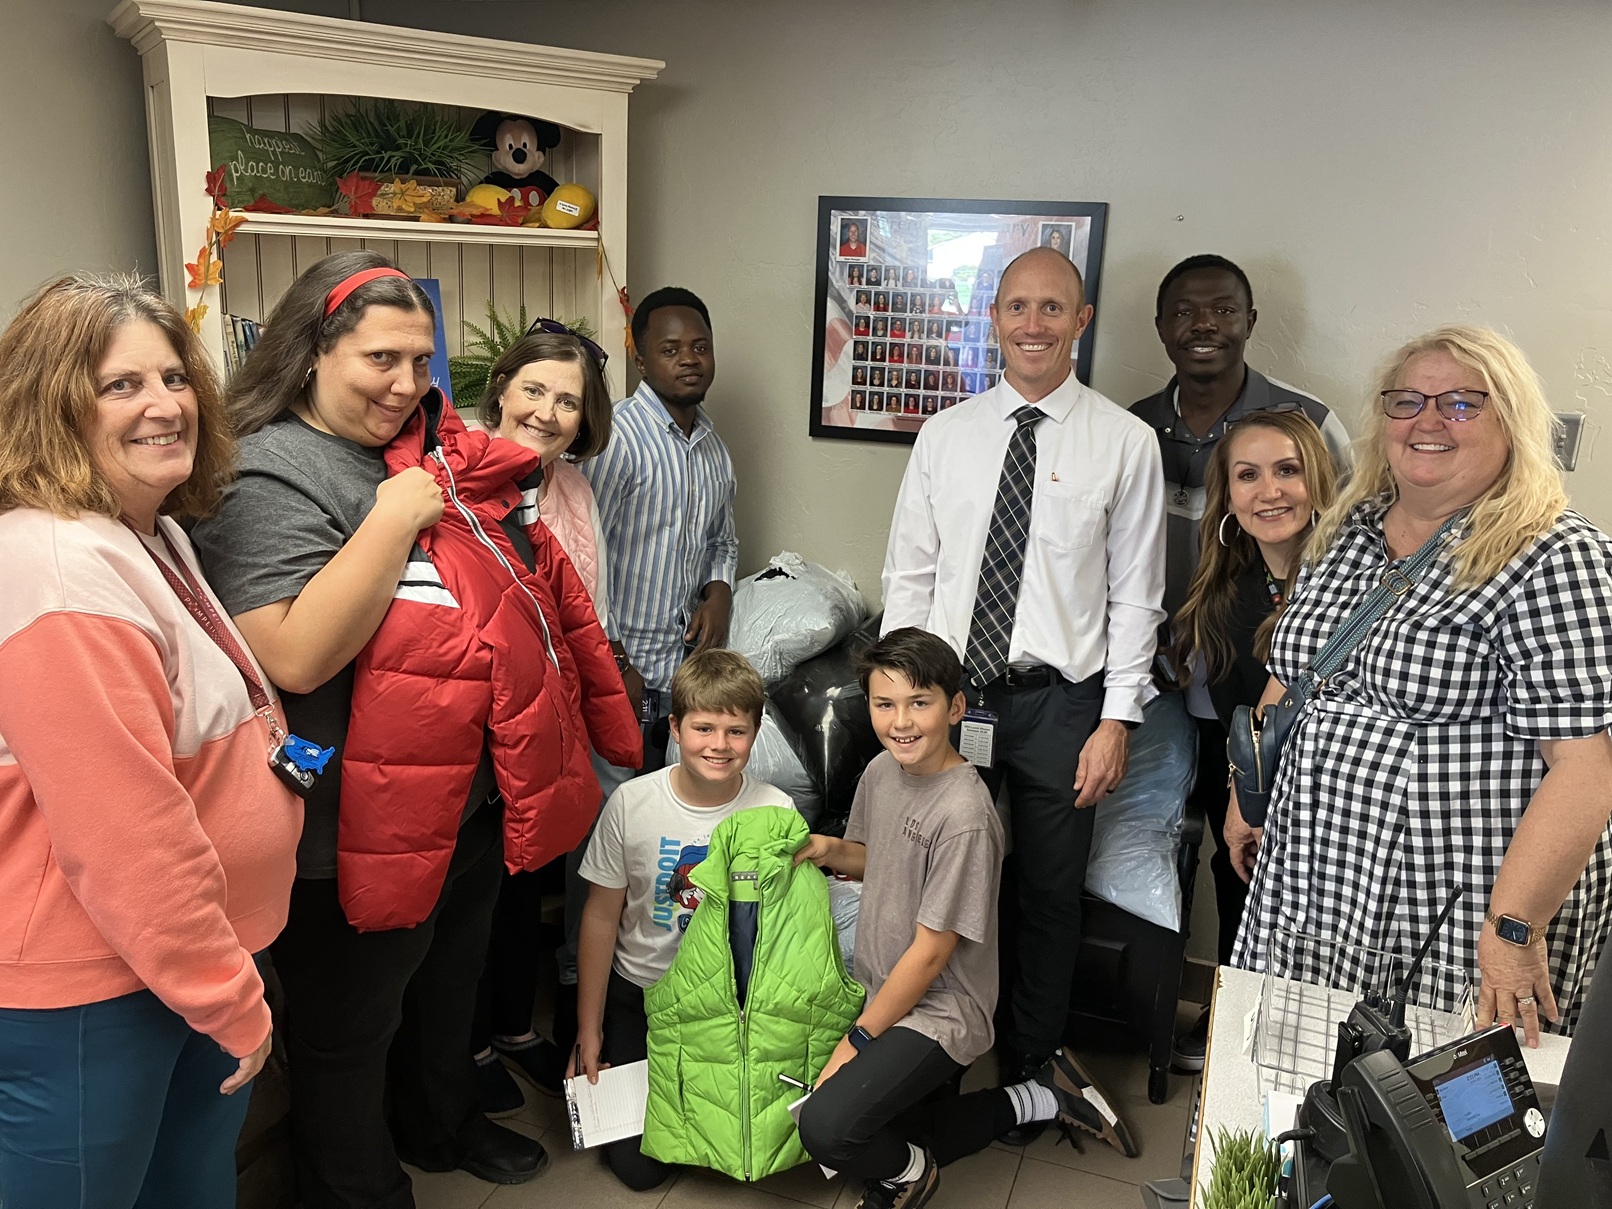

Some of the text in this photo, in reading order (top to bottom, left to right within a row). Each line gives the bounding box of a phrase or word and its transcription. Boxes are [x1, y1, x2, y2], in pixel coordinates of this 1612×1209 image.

[229, 150, 276, 186] place
[279, 164, 297, 181] on
[905, 816, 919, 830] LOS
